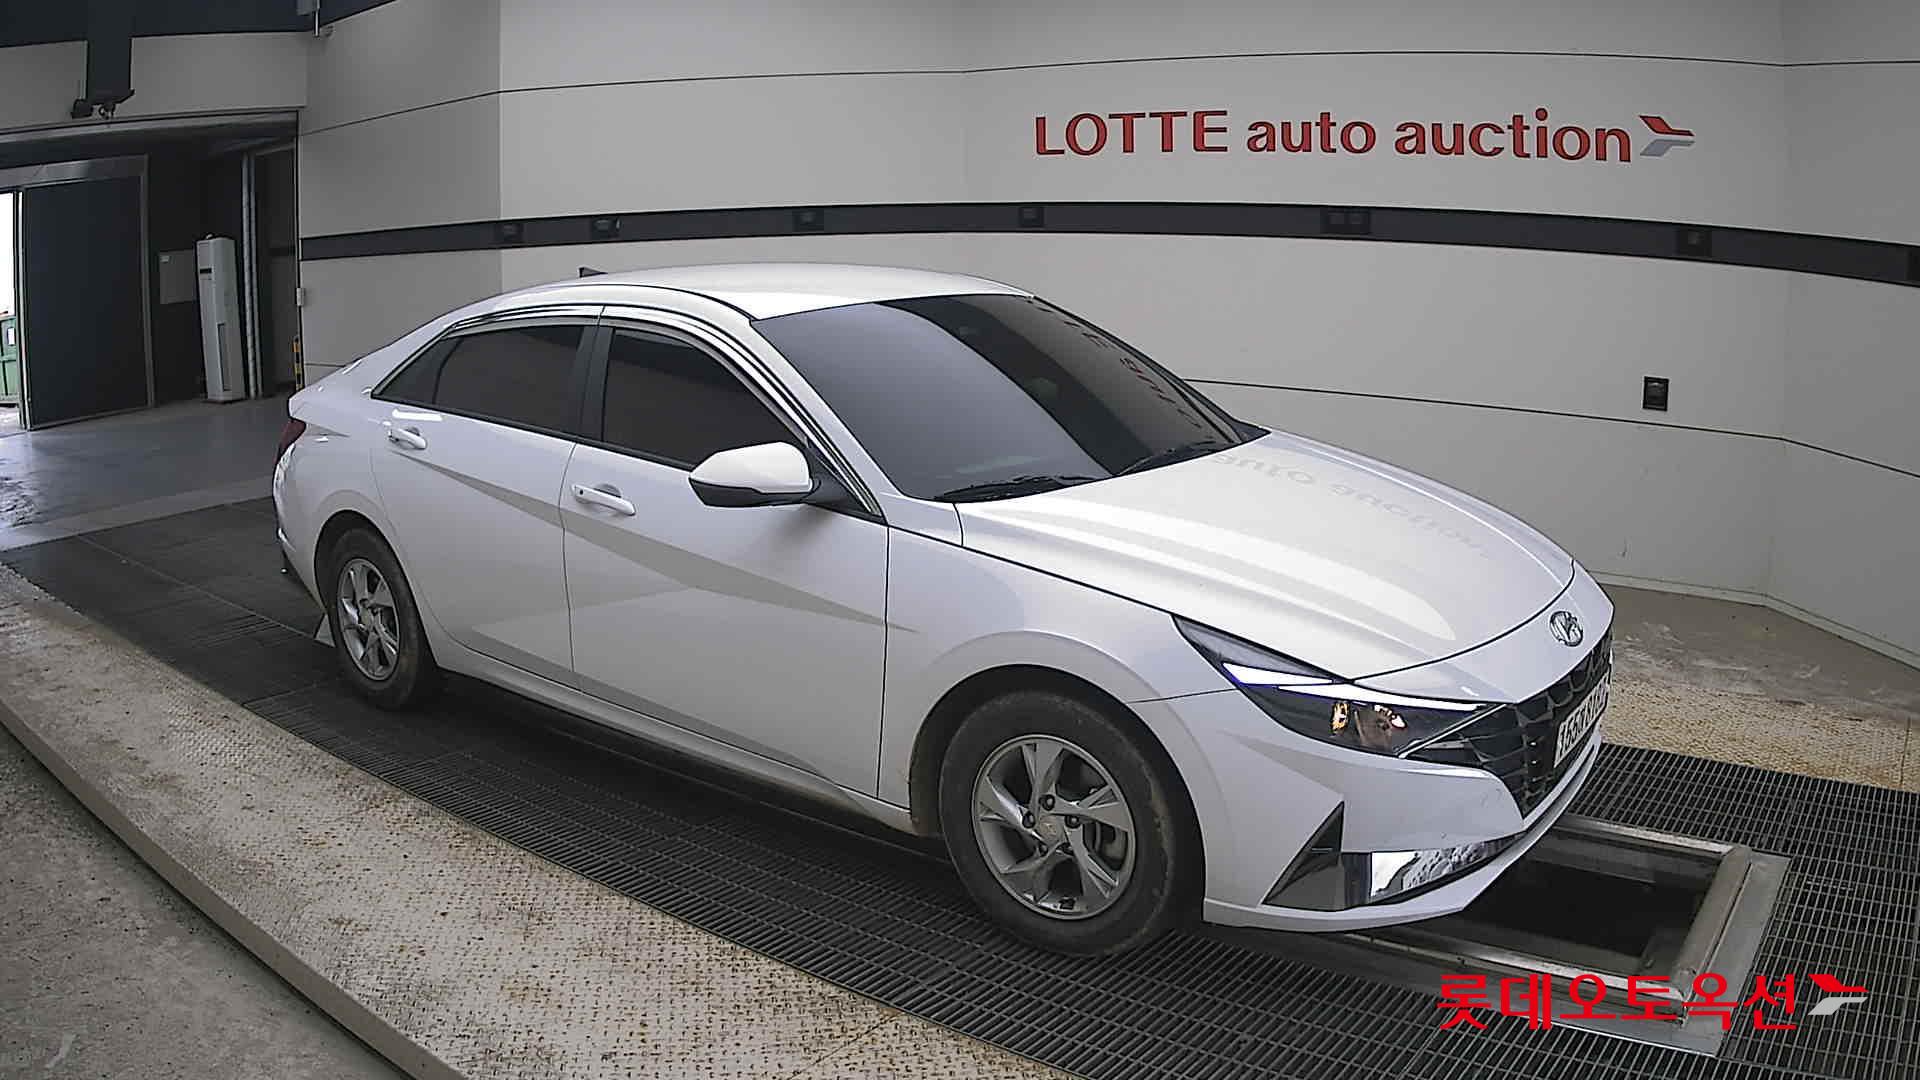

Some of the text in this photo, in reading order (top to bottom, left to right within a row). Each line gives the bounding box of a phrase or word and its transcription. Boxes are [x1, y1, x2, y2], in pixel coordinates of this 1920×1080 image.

[1034, 107, 1632, 163] LOTTE auto auction
